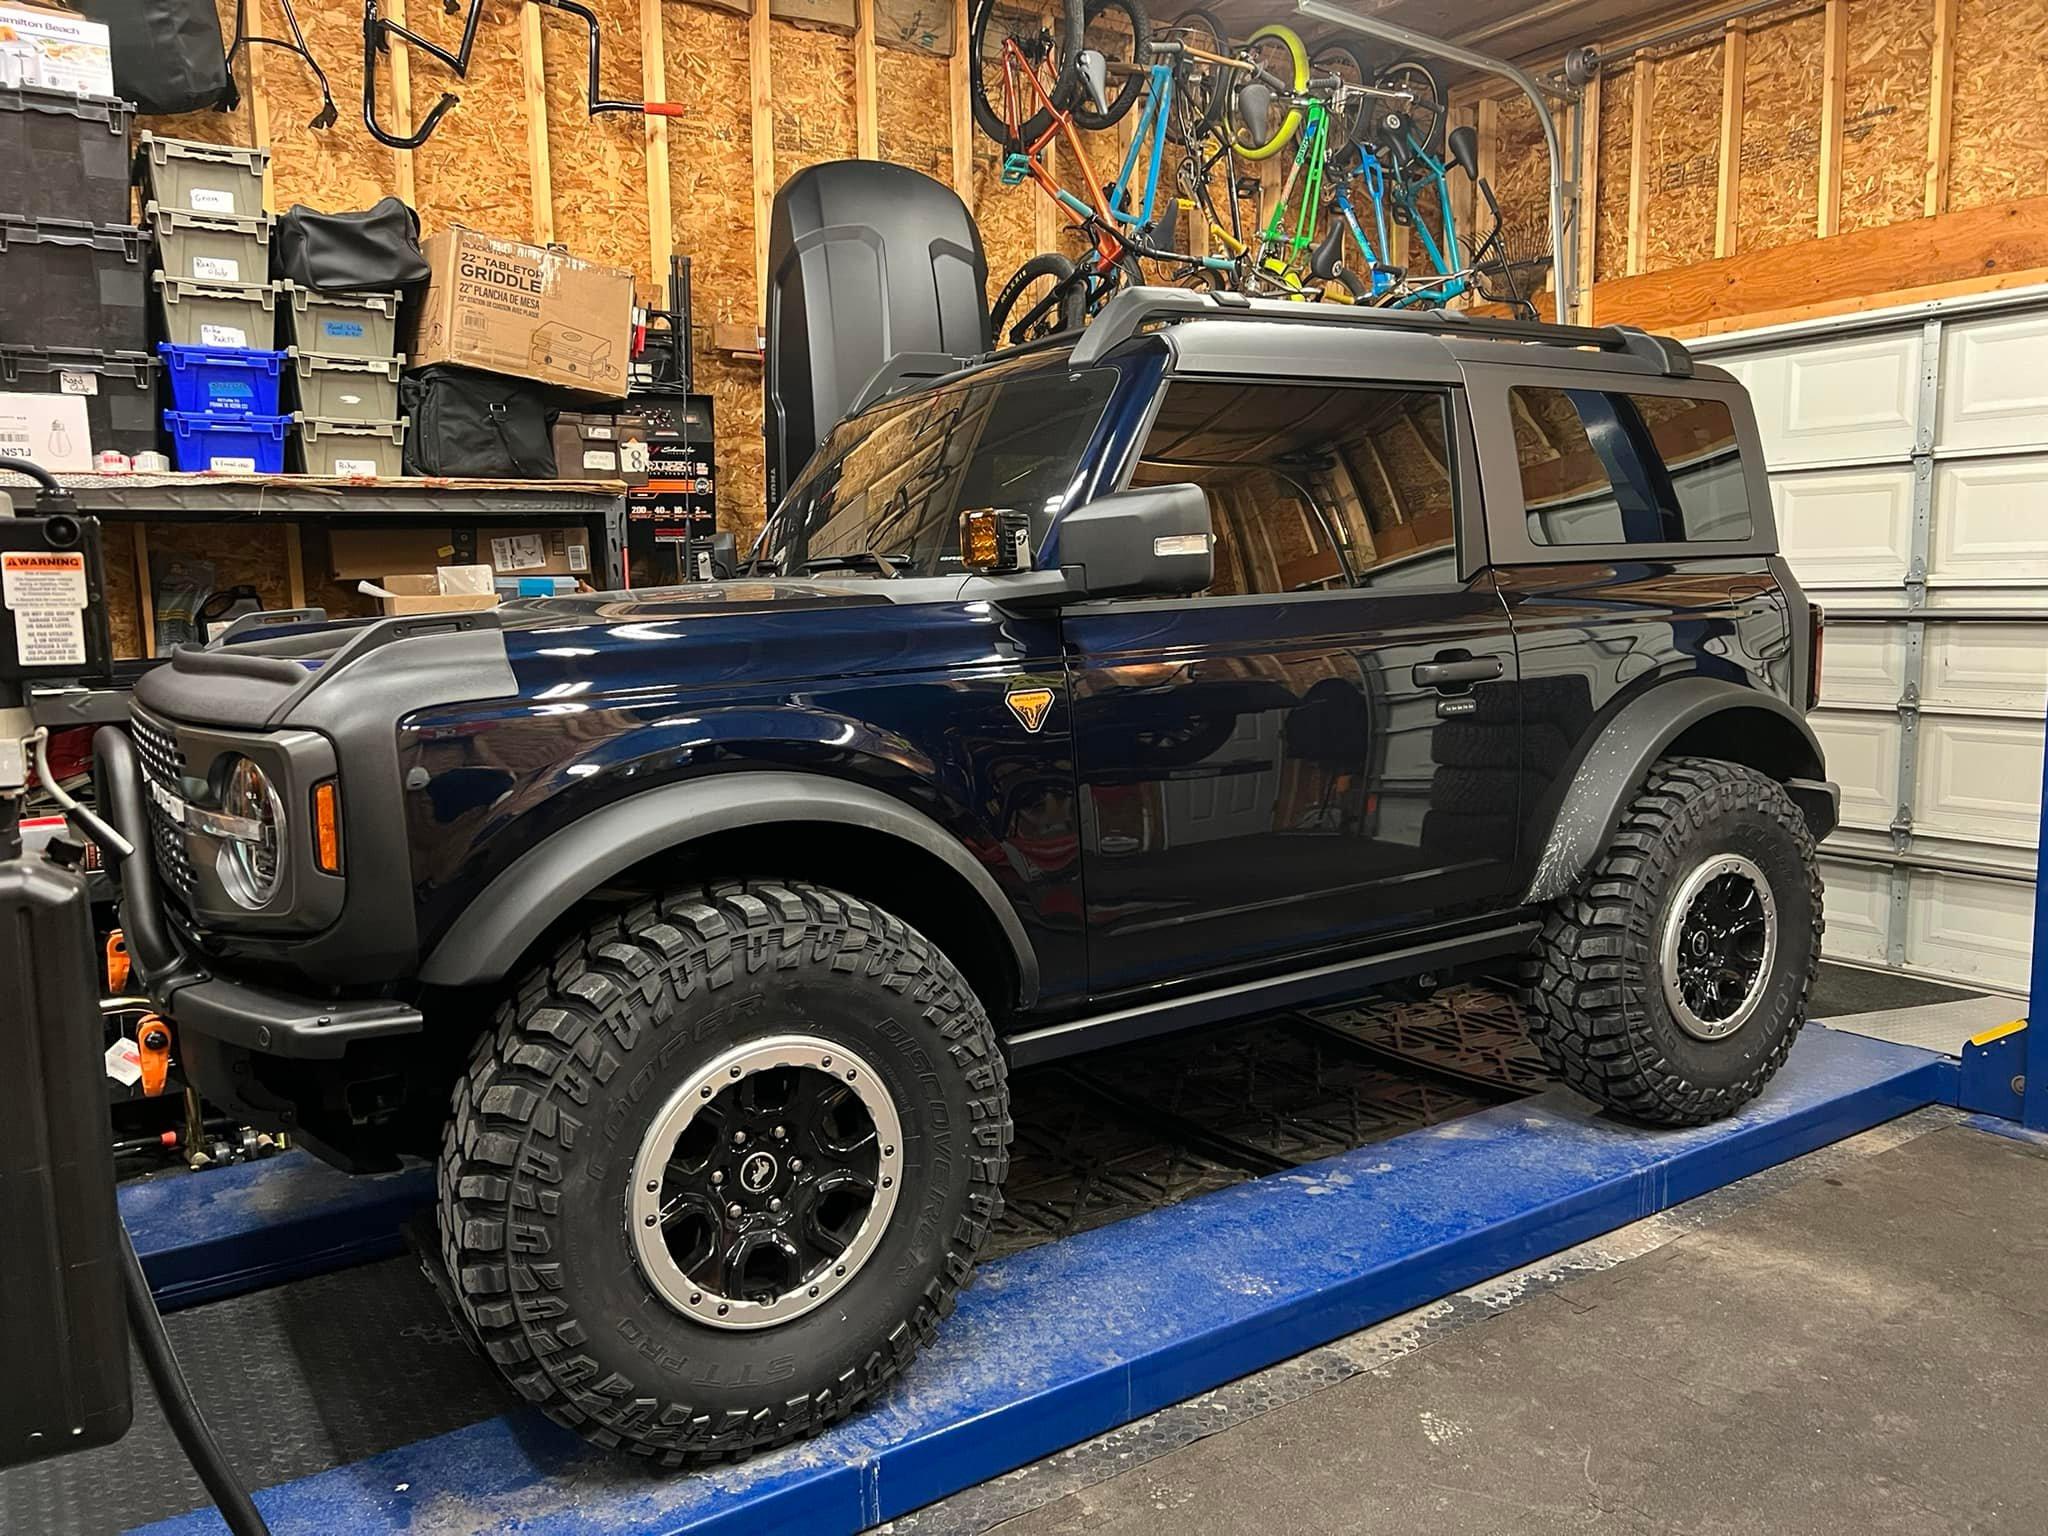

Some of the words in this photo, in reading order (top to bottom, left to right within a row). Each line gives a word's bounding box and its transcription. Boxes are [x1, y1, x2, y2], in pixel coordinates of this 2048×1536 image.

[45, 22, 80, 35] Beach
[460, 263, 542, 294] GRIDDLE
[473, 285, 508, 303] PLANCHA
[509, 293, 520, 306] DE
[520, 296, 540, 310] MESA
[631, 506, 647, 514] 200
[654, 506, 666, 514] 40
[20, 557, 80, 567] WARNING
